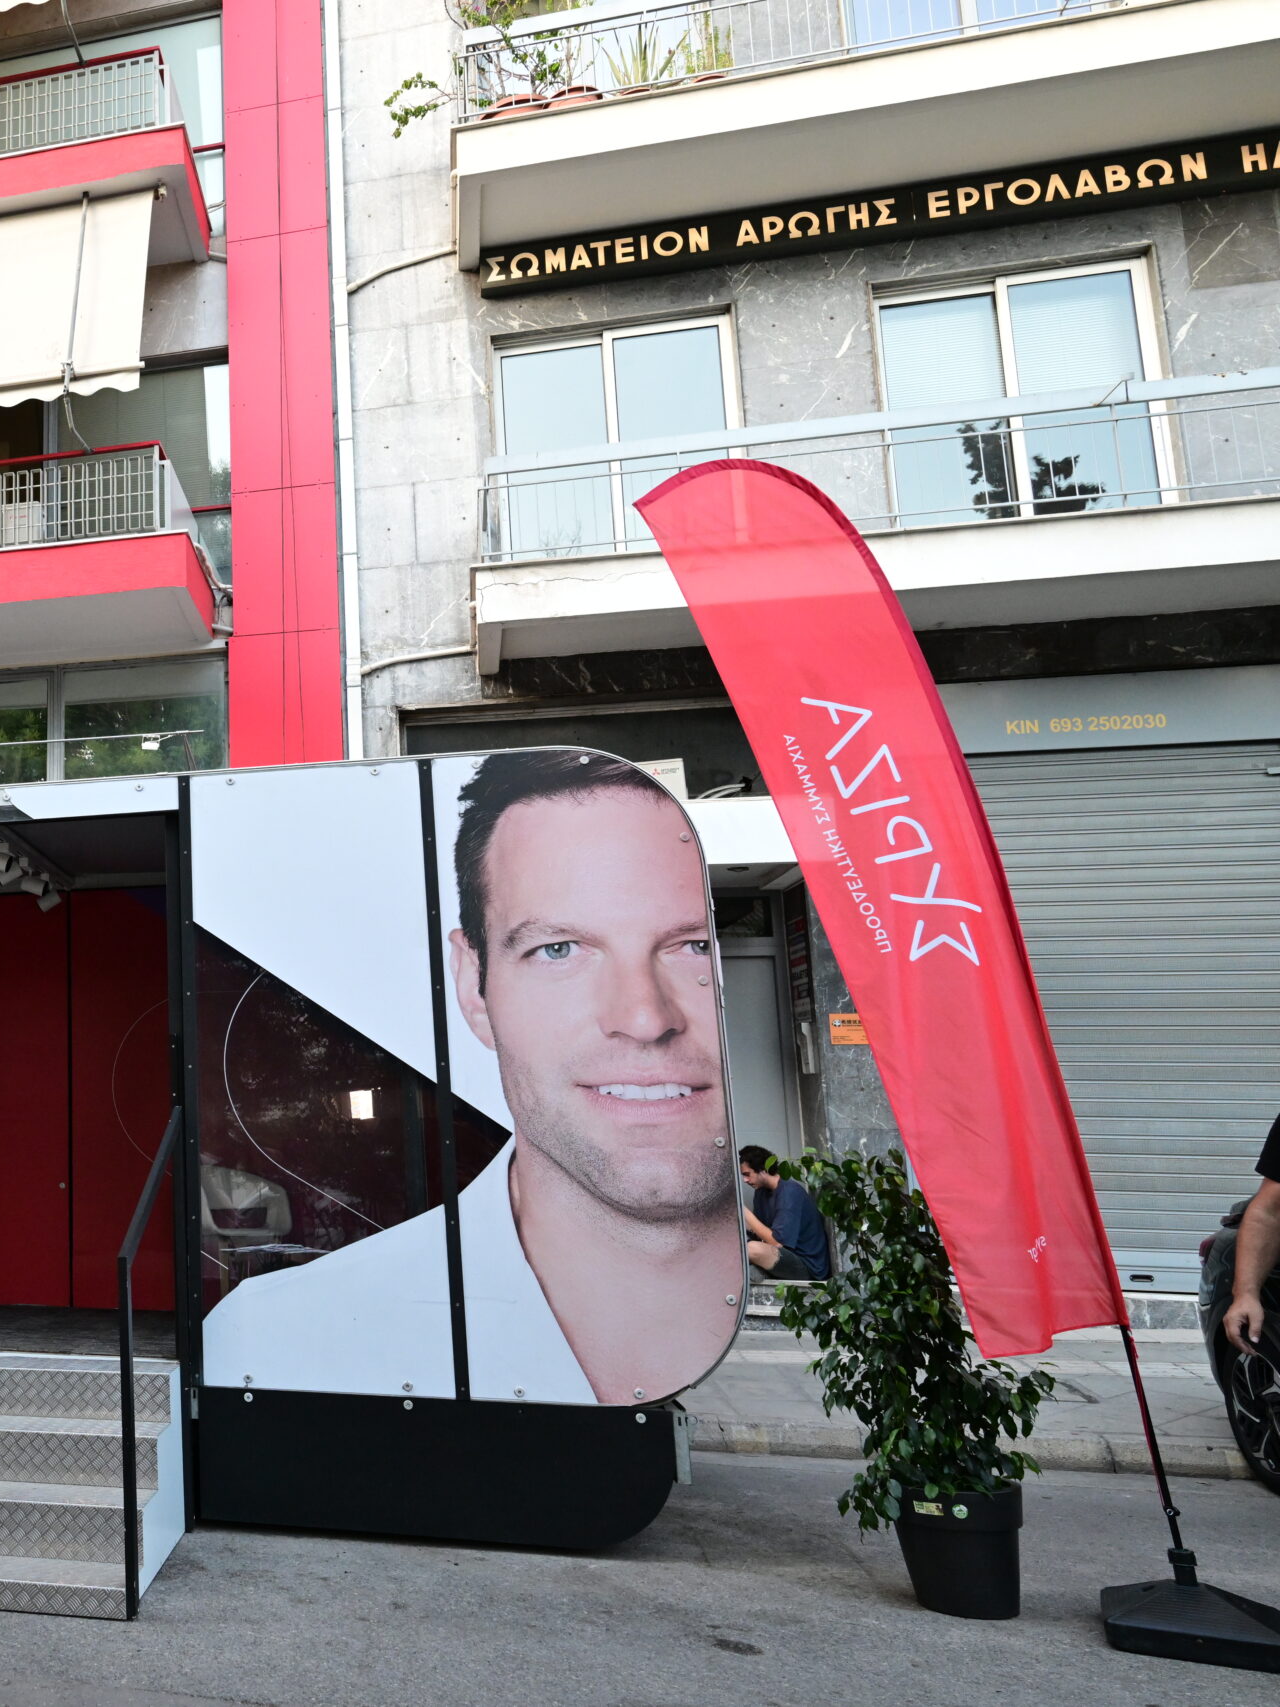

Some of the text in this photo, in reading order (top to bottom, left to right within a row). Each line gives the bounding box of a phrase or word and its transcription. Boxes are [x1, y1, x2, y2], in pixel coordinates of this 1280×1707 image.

[486, 225, 710, 283] ΣΩΜΑΤΕΙΟΝ
[736, 197, 898, 247] ΑΡΩΓΗΣ
[927, 151, 1208, 219] ΕΡΓΟΛΑΒΩΝ
[1050, 717, 1083, 733] 693
[1087, 713, 1167, 732] 2502030
